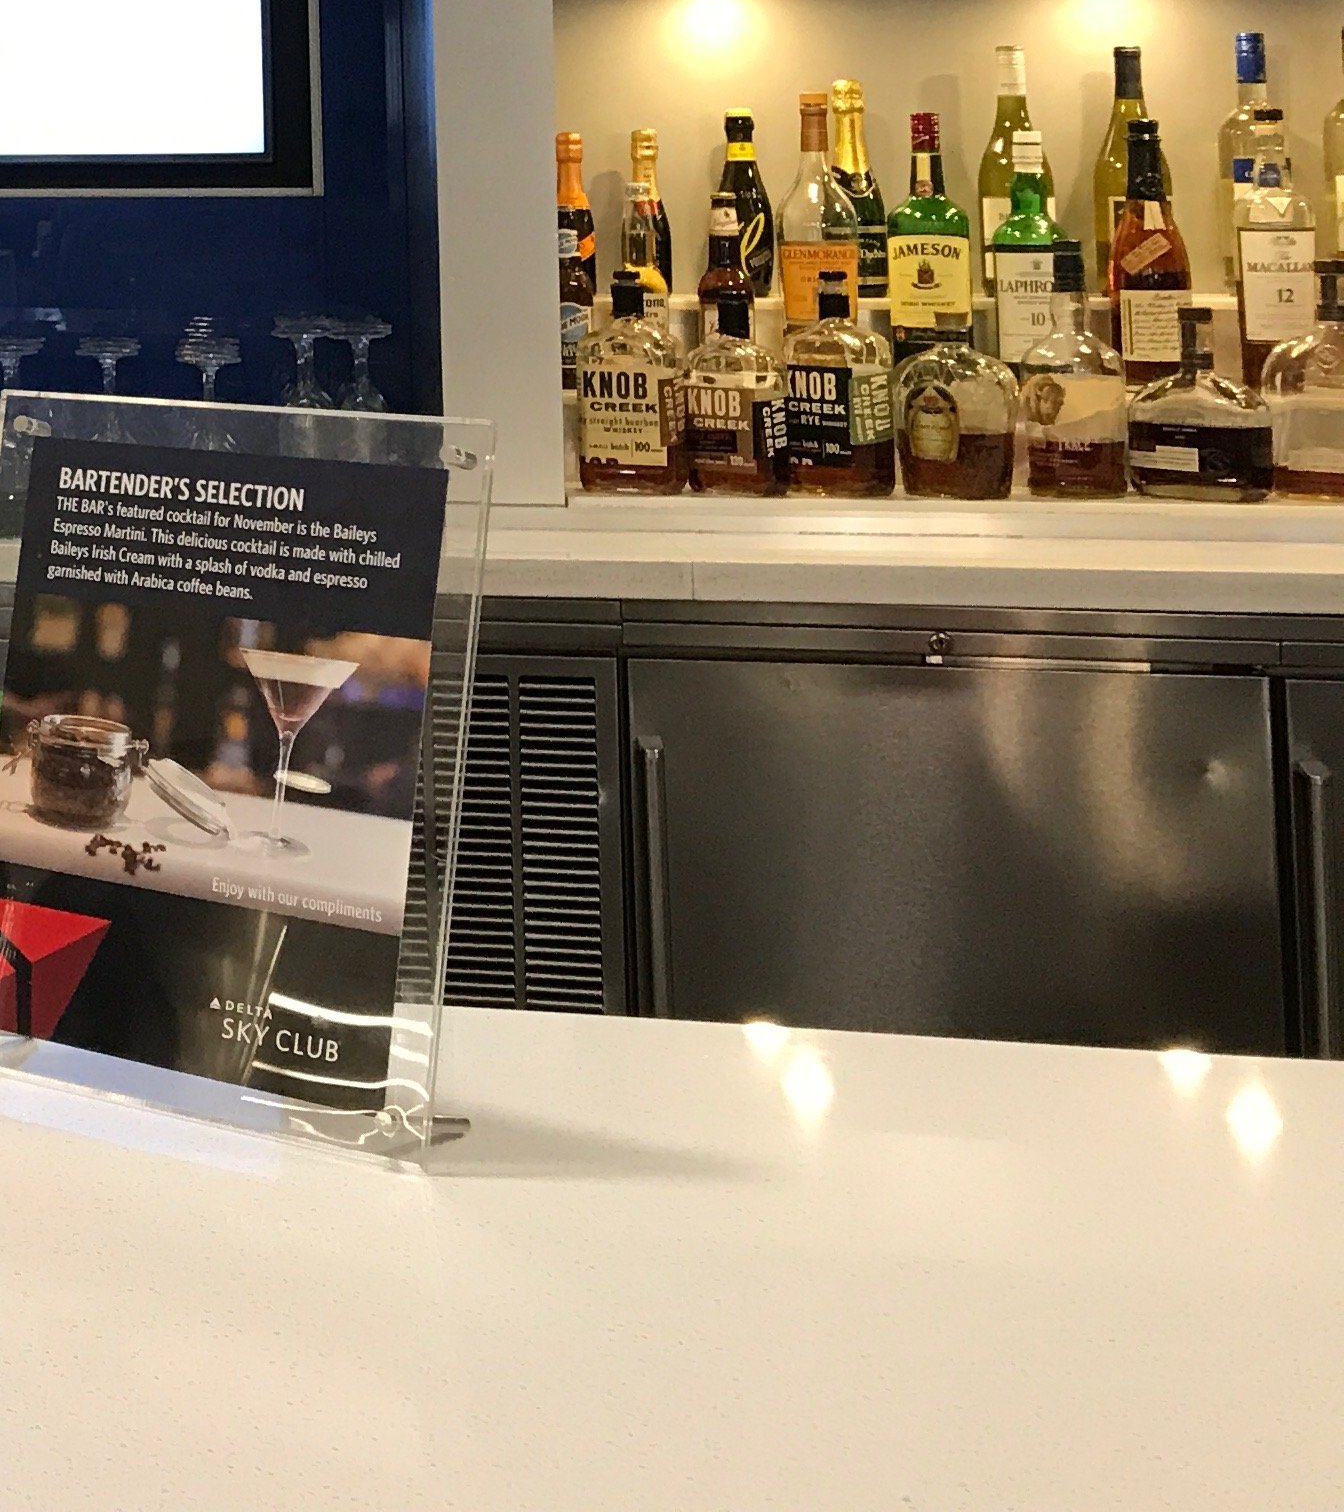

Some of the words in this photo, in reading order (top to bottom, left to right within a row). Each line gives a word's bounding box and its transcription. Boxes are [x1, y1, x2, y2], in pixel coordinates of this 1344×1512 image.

[892, 242, 962, 260] JAMESON
[999, 278, 1053, 293] LAPHRO
[1277, 288, 1295, 304] 12
[1030, 311, 1046, 326] 10
[583, 370, 648, 399] KNOB
[590, 402, 658, 414] CREEK
[687, 388, 741, 418] KNOB
[789, 401, 847, 416] CREEK
[693, 418, 752, 431] CREEK
[762, 405, 776, 459] CREEK
[771, 398, 788, 450] KNOB
[800, 415, 821, 426] RYE
[634, 441, 651, 453] 100
[58, 466, 190, 501] BARTENDER'S
[194, 479, 305, 512] SELECTION
[56, 495, 80, 513] THE
[80, 498, 114, 516] BAR's
[116, 502, 164, 521] featured
[166, 508, 212, 527] cocktail
[213, 512, 231, 529] for
[233, 514, 294, 535] November
[296, 520, 308, 536] is
[310, 521, 331, 538] the
[333, 523, 378, 545] Baileys
[53, 518, 102, 537] Espresso
[103, 523, 148, 542] Martini.
[151, 527, 175, 545] This
[177, 531, 228, 551] delicious
[230, 538, 277, 557] cocktail
[279, 541, 290, 558] is
[292, 544, 326, 561] made
[328, 547, 356, 565] with
[358, 550, 402, 569] chilled
[50, 539, 89, 561] Baileys
[91, 544, 116, 561] Irish
[118, 547, 155, 566] Cream
[157, 552, 183, 569] with
[184, 557, 193, 570] a
[195, 555, 232, 575] splash
[234, 560, 248, 576] of
[249, 563, 285, 580] vodka
[287, 567, 312, 583] and
[313, 572, 369, 589] espresso
[46, 565, 102, 582] garnished
[103, 569, 129, 585] with
[130, 571, 175, 590] Arabica
[176, 578, 213, 595] coffee
[214, 580, 254, 600] beans.
[212, 876, 244, 900] Enjoy
[247, 885, 275, 903] with
[278, 893, 298, 907] our
[301, 896, 383, 923] compliments
[225, 999, 273, 1020] DELTA
[221, 1017, 270, 1046] SKY
[275, 1028, 340, 1062] CLUB
